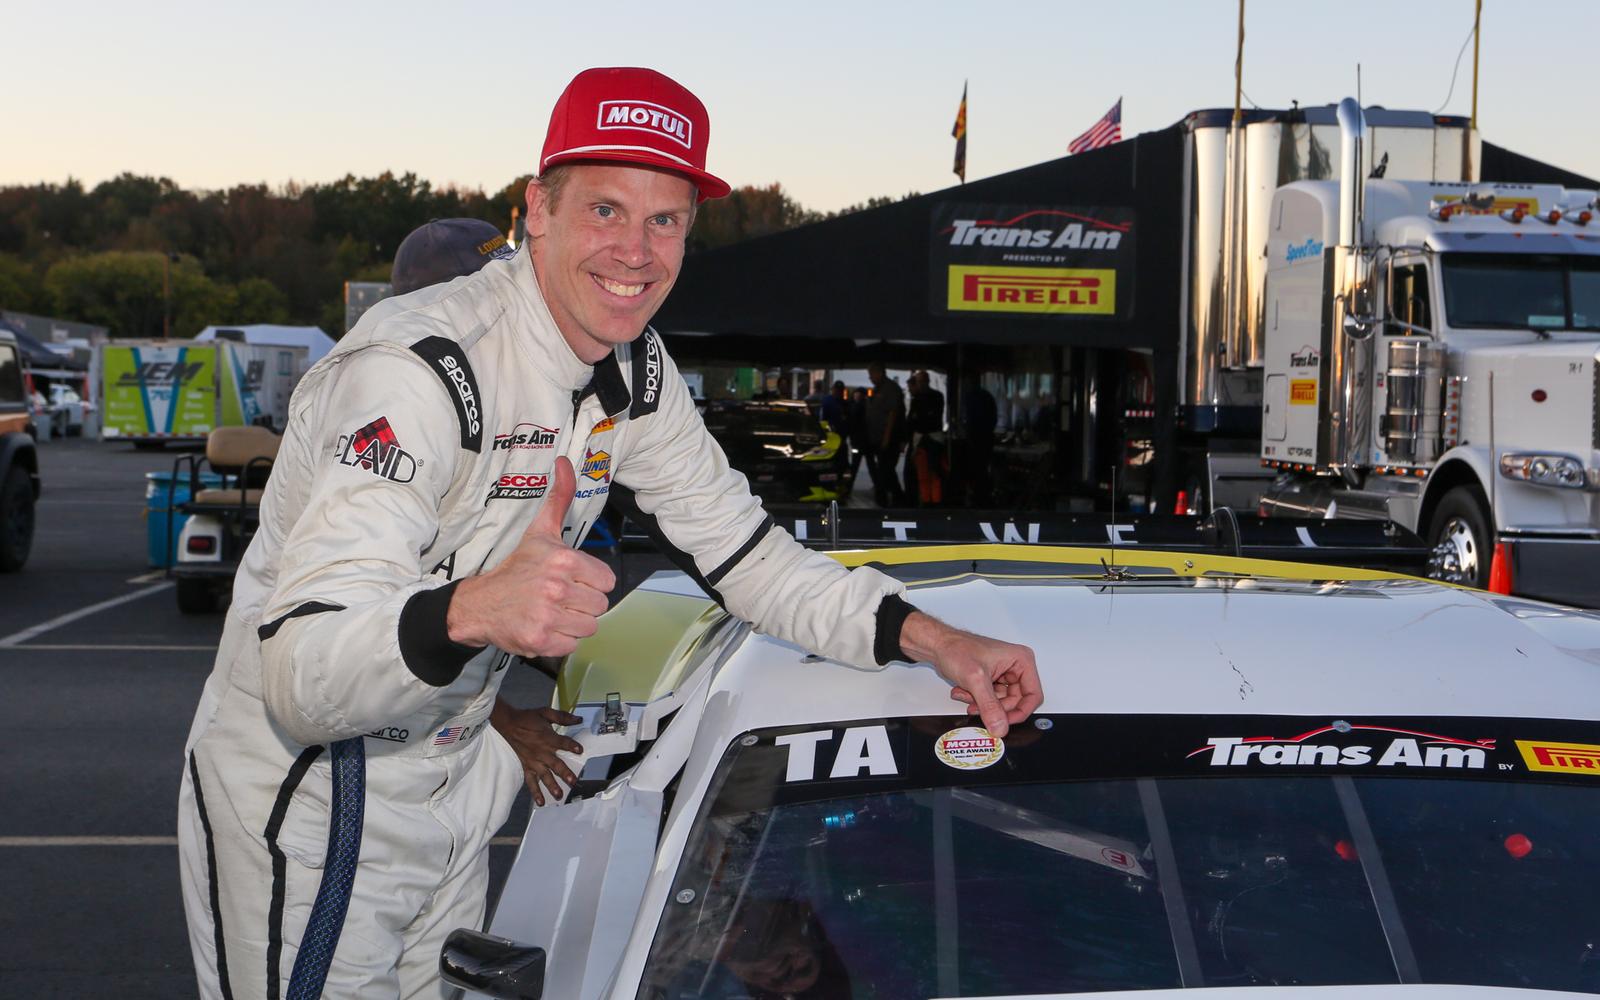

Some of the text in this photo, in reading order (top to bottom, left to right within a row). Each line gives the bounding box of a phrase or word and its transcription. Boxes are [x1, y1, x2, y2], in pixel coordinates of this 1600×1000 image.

[606, 106, 686, 140] MOTUL
[949, 219, 1122, 250] Trans Am
[1002, 254, 1067, 263] PRESENTED BY
[963, 274, 1101, 305] PIRELLI
[644, 332, 661, 403] sparco
[1290, 352, 1318, 367] Trans Am
[120, 362, 204, 381] JEM
[438, 355, 481, 438] sparco
[1291, 384, 1315, 401] PIRELLI
[528, 429, 556, 445] Am
[334, 433, 417, 484] PLAID
[498, 475, 548, 487] SCCA
[500, 488, 545, 497] RACING
[575, 489, 595, 499] ACE
[946, 739, 993, 748] MOTUL
[1206, 737, 1373, 767] Trans
[1376, 738, 1487, 769] Am
[1531, 746, 1600, 769] PIR
[775, 725, 899, 782] TA
